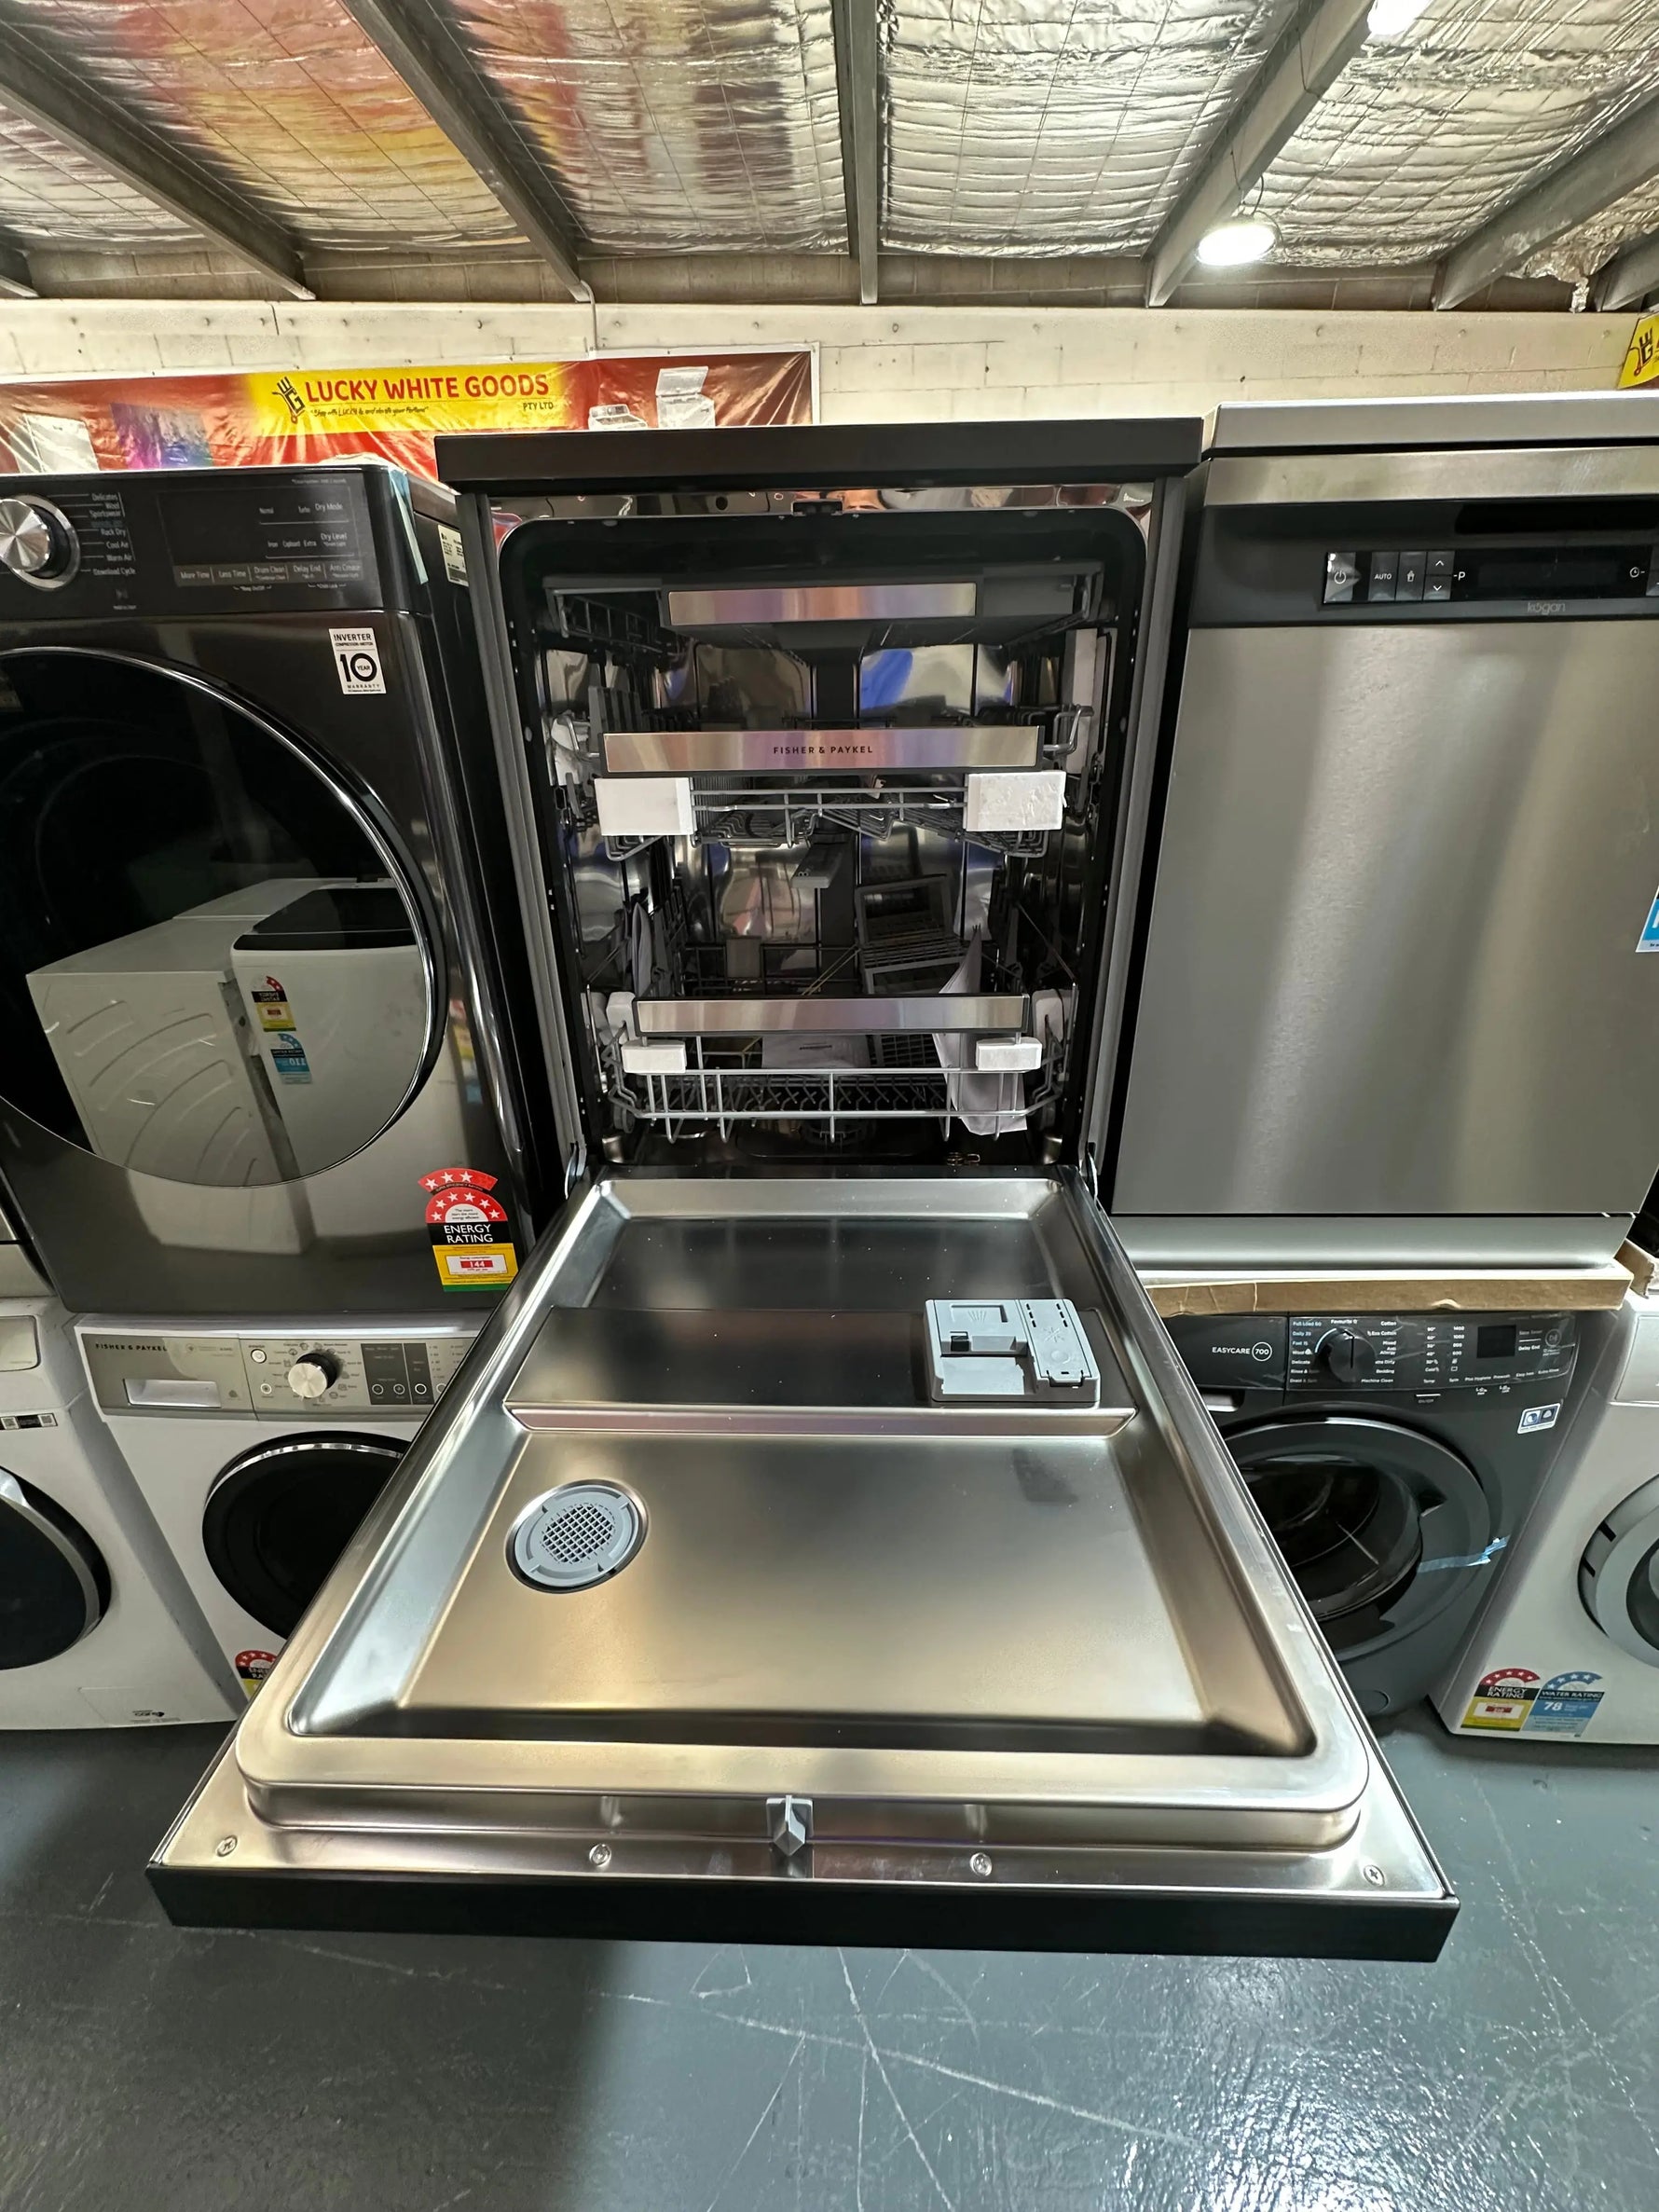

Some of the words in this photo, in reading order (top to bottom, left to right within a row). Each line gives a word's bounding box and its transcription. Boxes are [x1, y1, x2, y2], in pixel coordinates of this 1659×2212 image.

[305, 379, 378, 403] LUCKY
[383, 376, 459, 400] WHITE
[464, 374, 550, 398] GOODS
[523, 402, 538, 411] PTY
[539, 401, 554, 410] LTD
[315, 503, 326, 512] Dry
[326, 502, 343, 511] Mode
[115, 529, 126, 538] Dry
[321, 532, 332, 542] Dry
[333, 532, 348, 541] Level
[232, 570, 246, 578] Time
[294, 565, 309, 573] Delay
[197, 570, 211, 579] Time
[1528, 601, 1566, 615] kogan
[334, 633, 372, 641] INVERTER
[340, 653, 377, 682] 10
[774, 746, 815, 754] FISHER
[818, 746, 826, 754] &
[444, 1224, 491, 1234] ENERGY
[446, 1234, 494, 1243] RATING
[1543, 1701, 1562, 1711] 78
